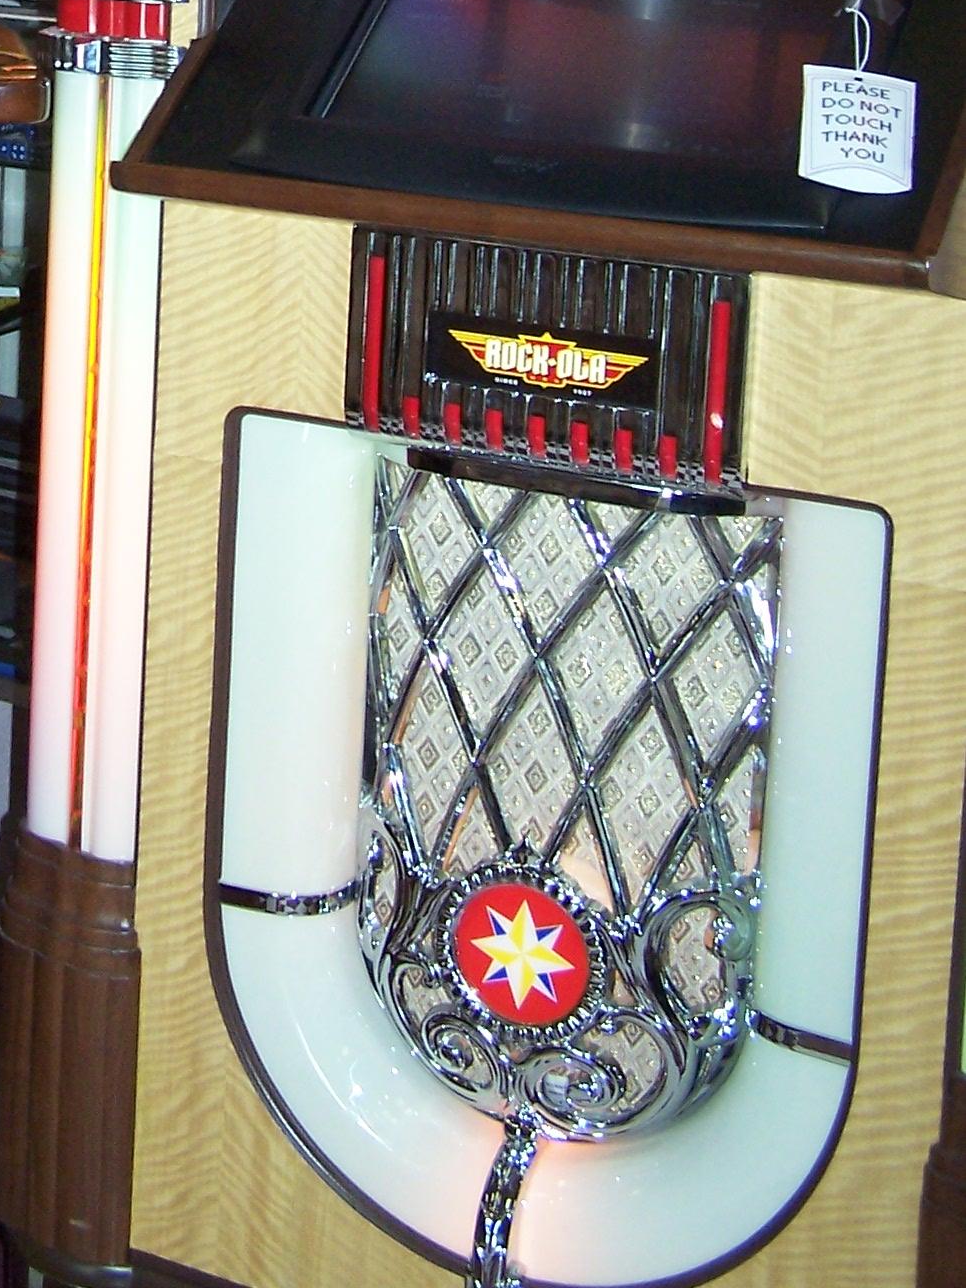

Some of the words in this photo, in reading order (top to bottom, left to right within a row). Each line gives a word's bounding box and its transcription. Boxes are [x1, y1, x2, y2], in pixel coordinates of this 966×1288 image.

[821, 80, 892, 101] PLEASE
[821, 97, 855, 110] DO
[859, 100, 903, 119] NOT
[821, 113, 893, 134] TOUCH
[821, 130, 889, 150] THANK
[839, 146, 886, 164] YOU
